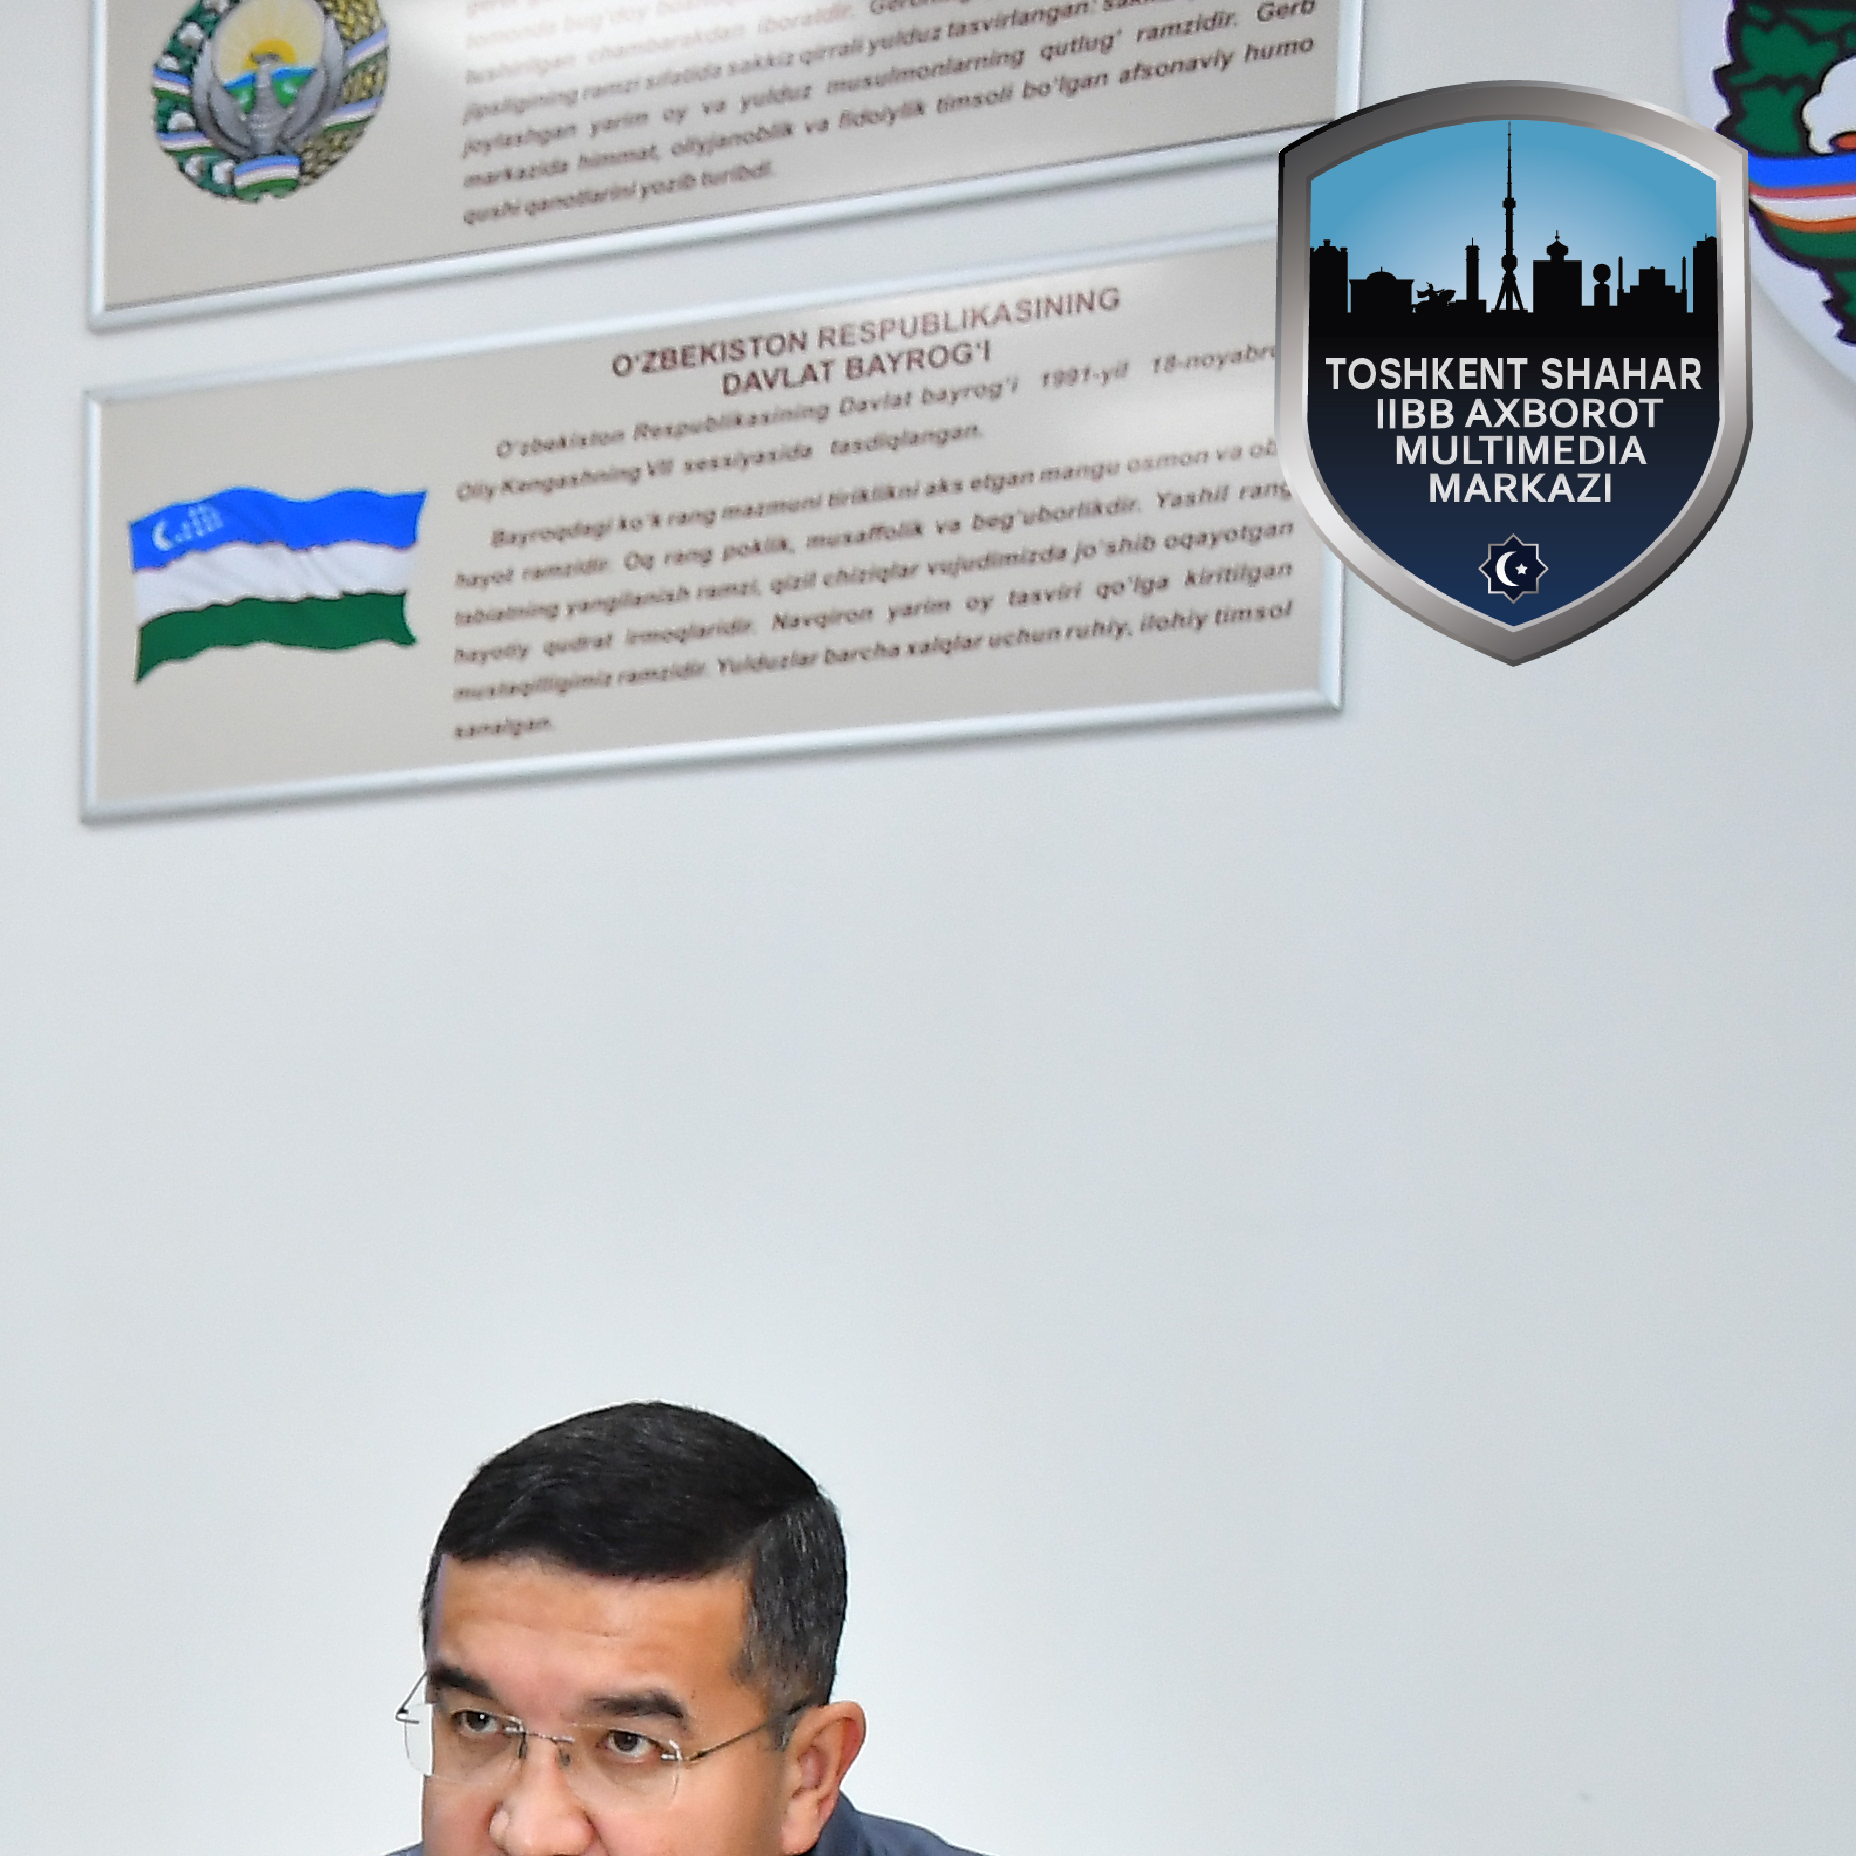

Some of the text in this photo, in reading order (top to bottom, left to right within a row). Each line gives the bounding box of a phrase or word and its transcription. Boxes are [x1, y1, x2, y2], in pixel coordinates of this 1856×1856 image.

[1244, 38, 1315, 62] humo
[611, 287, 1121, 377] O'ZBEKISTON RESPUBLIKASINING
[721, 340, 991, 396] DAVLAT BAYROG'I
